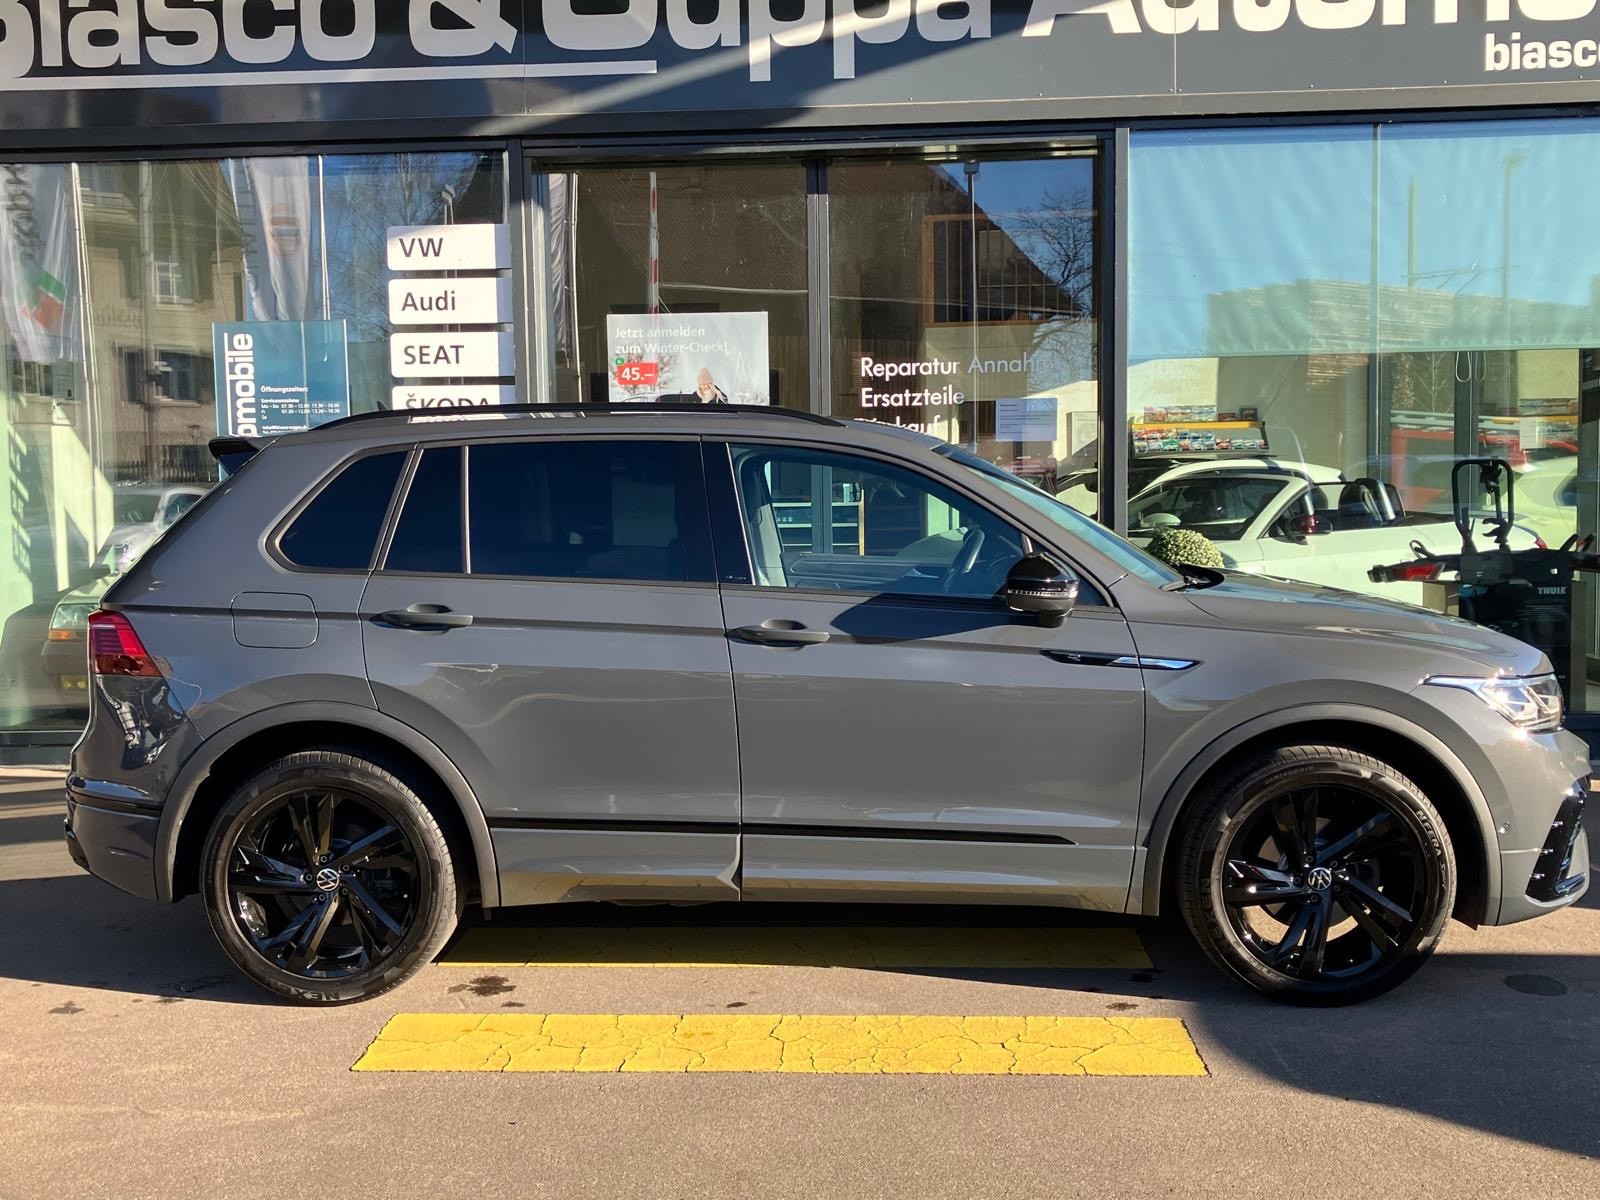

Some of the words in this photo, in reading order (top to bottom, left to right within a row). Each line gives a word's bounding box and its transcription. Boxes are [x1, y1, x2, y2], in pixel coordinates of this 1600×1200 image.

[1485, 32, 1600, 71] biasc
[399, 238, 443, 257] VW
[402, 290, 456, 311] Audi
[615, 327, 644, 338] Jetzt
[647, 326, 705, 337] anmelden
[404, 345, 464, 365] SEAT
[615, 345, 641, 354] zum
[861, 357, 960, 381] Reparatur
[861, 384, 965, 408] Ersatzteile
[1537, 586, 1567, 594] THULE
